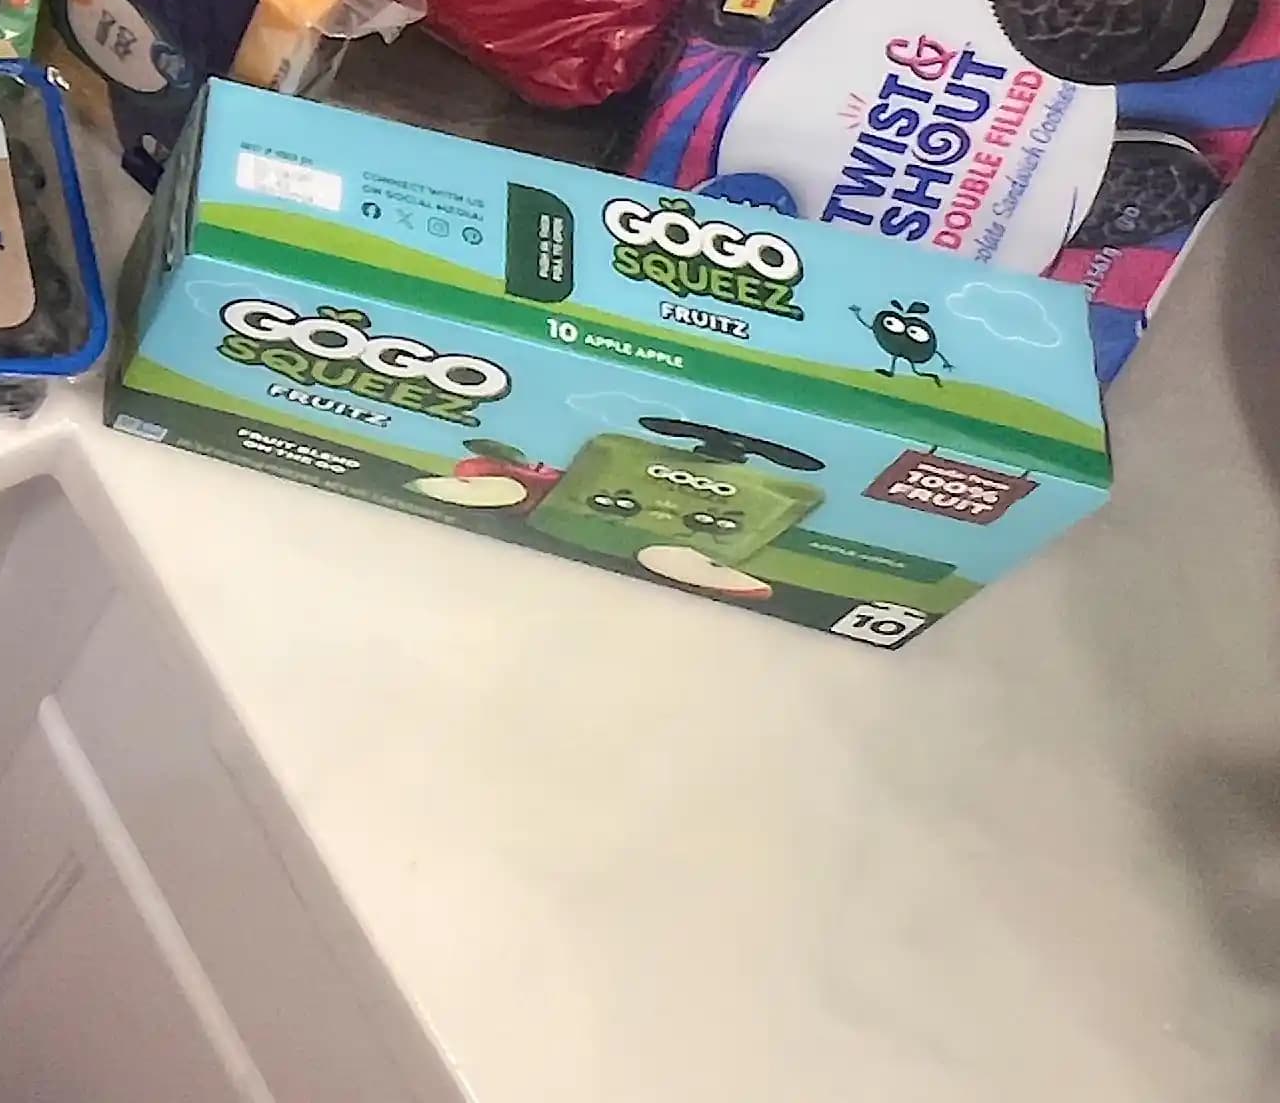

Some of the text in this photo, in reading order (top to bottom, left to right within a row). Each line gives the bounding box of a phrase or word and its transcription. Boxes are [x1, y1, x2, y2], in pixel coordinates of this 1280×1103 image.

[819, 34, 958, 227] TWIST &
[878, 50, 1009, 242] SHOUT
[932, 69, 1045, 251] DOUBLE FILLED
[603, 198, 802, 283] GOGO
[613, 244, 804, 320] SQUEEZ
[546, 317, 685, 369] 10 APPLE APPLE
[660, 301, 750, 340] FRUITZ
[220, 298, 512, 400] GOGO
[217, 334, 481, 428] SQUEEZ
[267, 382, 392, 428] FRUITZ
[237, 427, 362, 470] FRUIT BLEND
[242, 439, 348, 475] ON THE GO
[646, 463, 738, 497] GOGO
[888, 482, 995, 516] FRUIT
[906, 470, 1001, 504] 100%
[851, 613, 907, 638] 10
